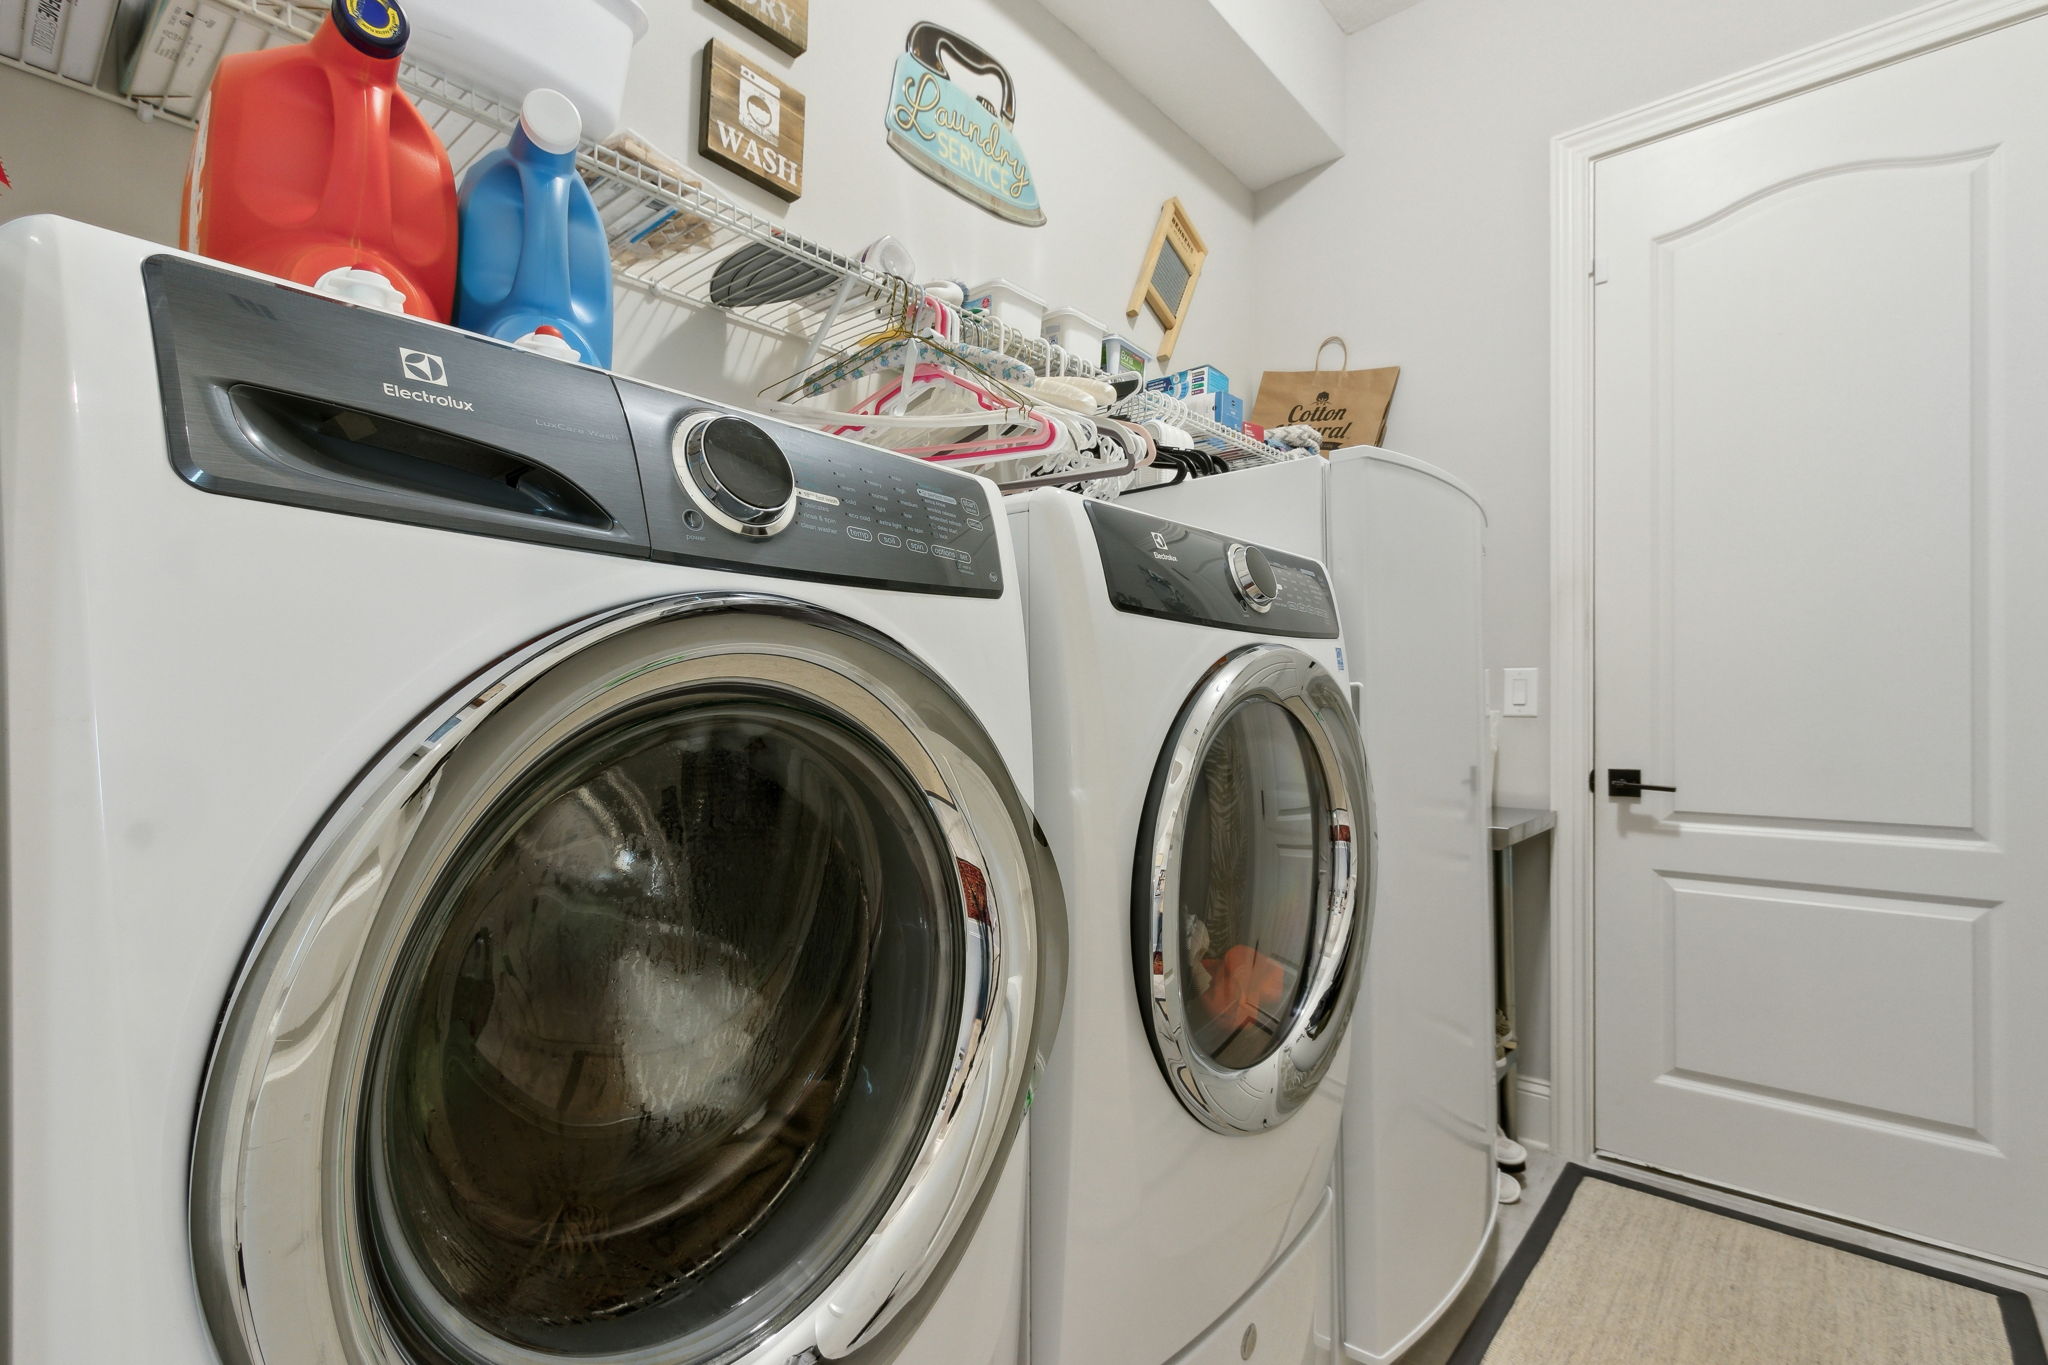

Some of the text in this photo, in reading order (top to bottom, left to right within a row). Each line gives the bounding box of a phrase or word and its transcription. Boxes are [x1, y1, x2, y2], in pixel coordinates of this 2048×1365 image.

[745, 0, 797, 31] RY
[894, 73, 1029, 198] Laundry
[717, 119, 798, 186] WASH
[937, 131, 1010, 195] SERVICE
[382, 382, 475, 412] Electrolux
[1287, 404, 1347, 423] Cotton
[535, 418, 584, 434] LuxCare
[849, 527, 869, 540] temp
[884, 535, 896, 545] soil
[910, 541, 924, 552] spin
[935, 547, 956, 559] options
[1153, 551, 1178, 562] Electrolux
